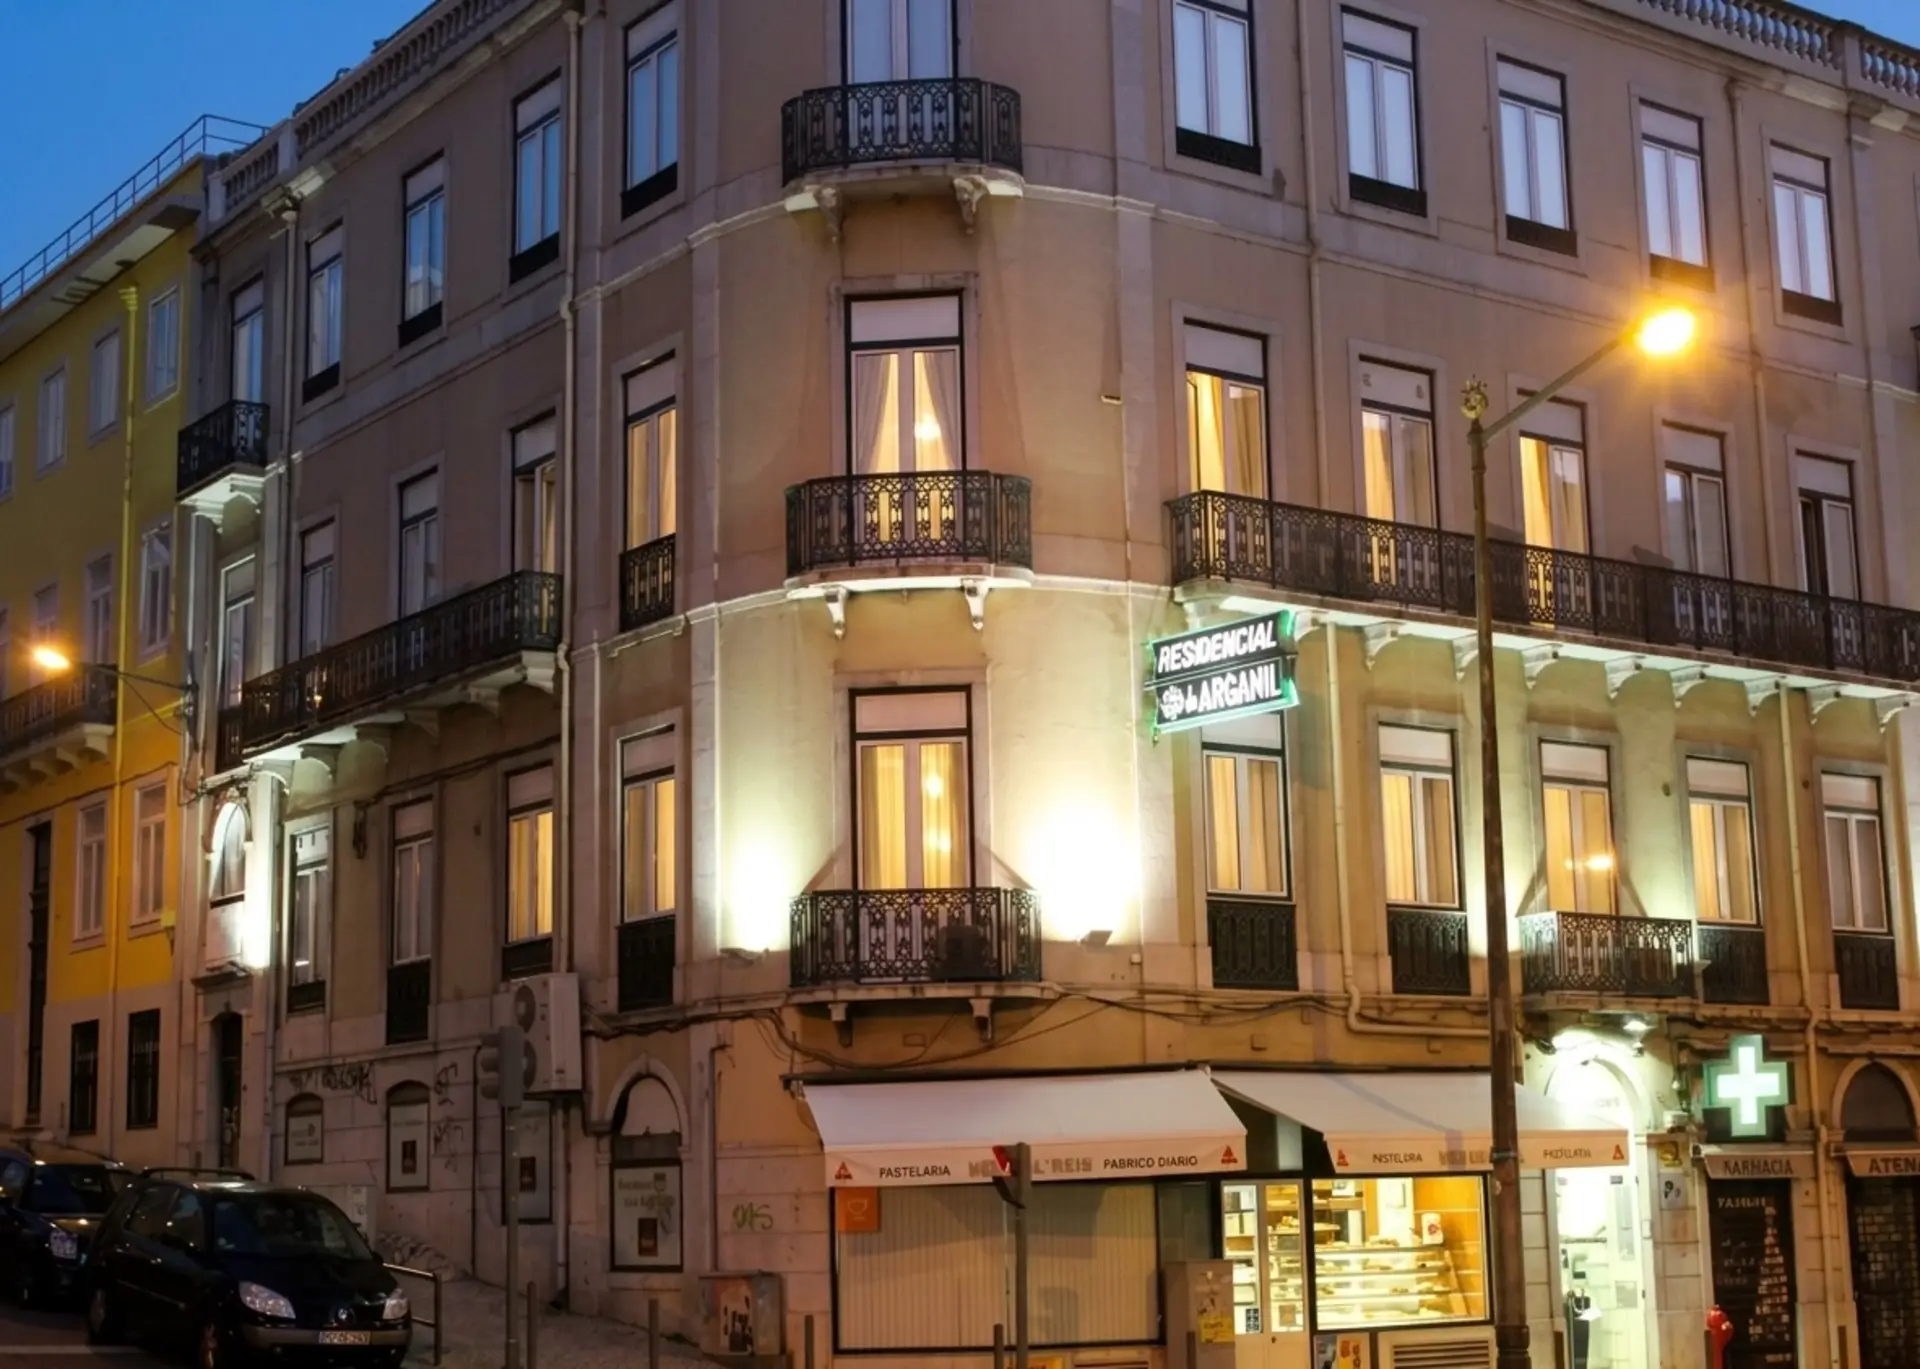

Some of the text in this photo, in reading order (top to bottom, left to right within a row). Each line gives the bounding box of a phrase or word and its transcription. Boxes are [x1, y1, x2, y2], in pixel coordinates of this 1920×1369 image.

[1157, 620, 1278, 674] RESIDENCIAL
[1197, 663, 1282, 713] ARGANIL
[879, 1165, 951, 1179] PASTELARIA
[1158, 1155, 1198, 1168] DIARIO
[1869, 1156, 1920, 1174] ATEN
